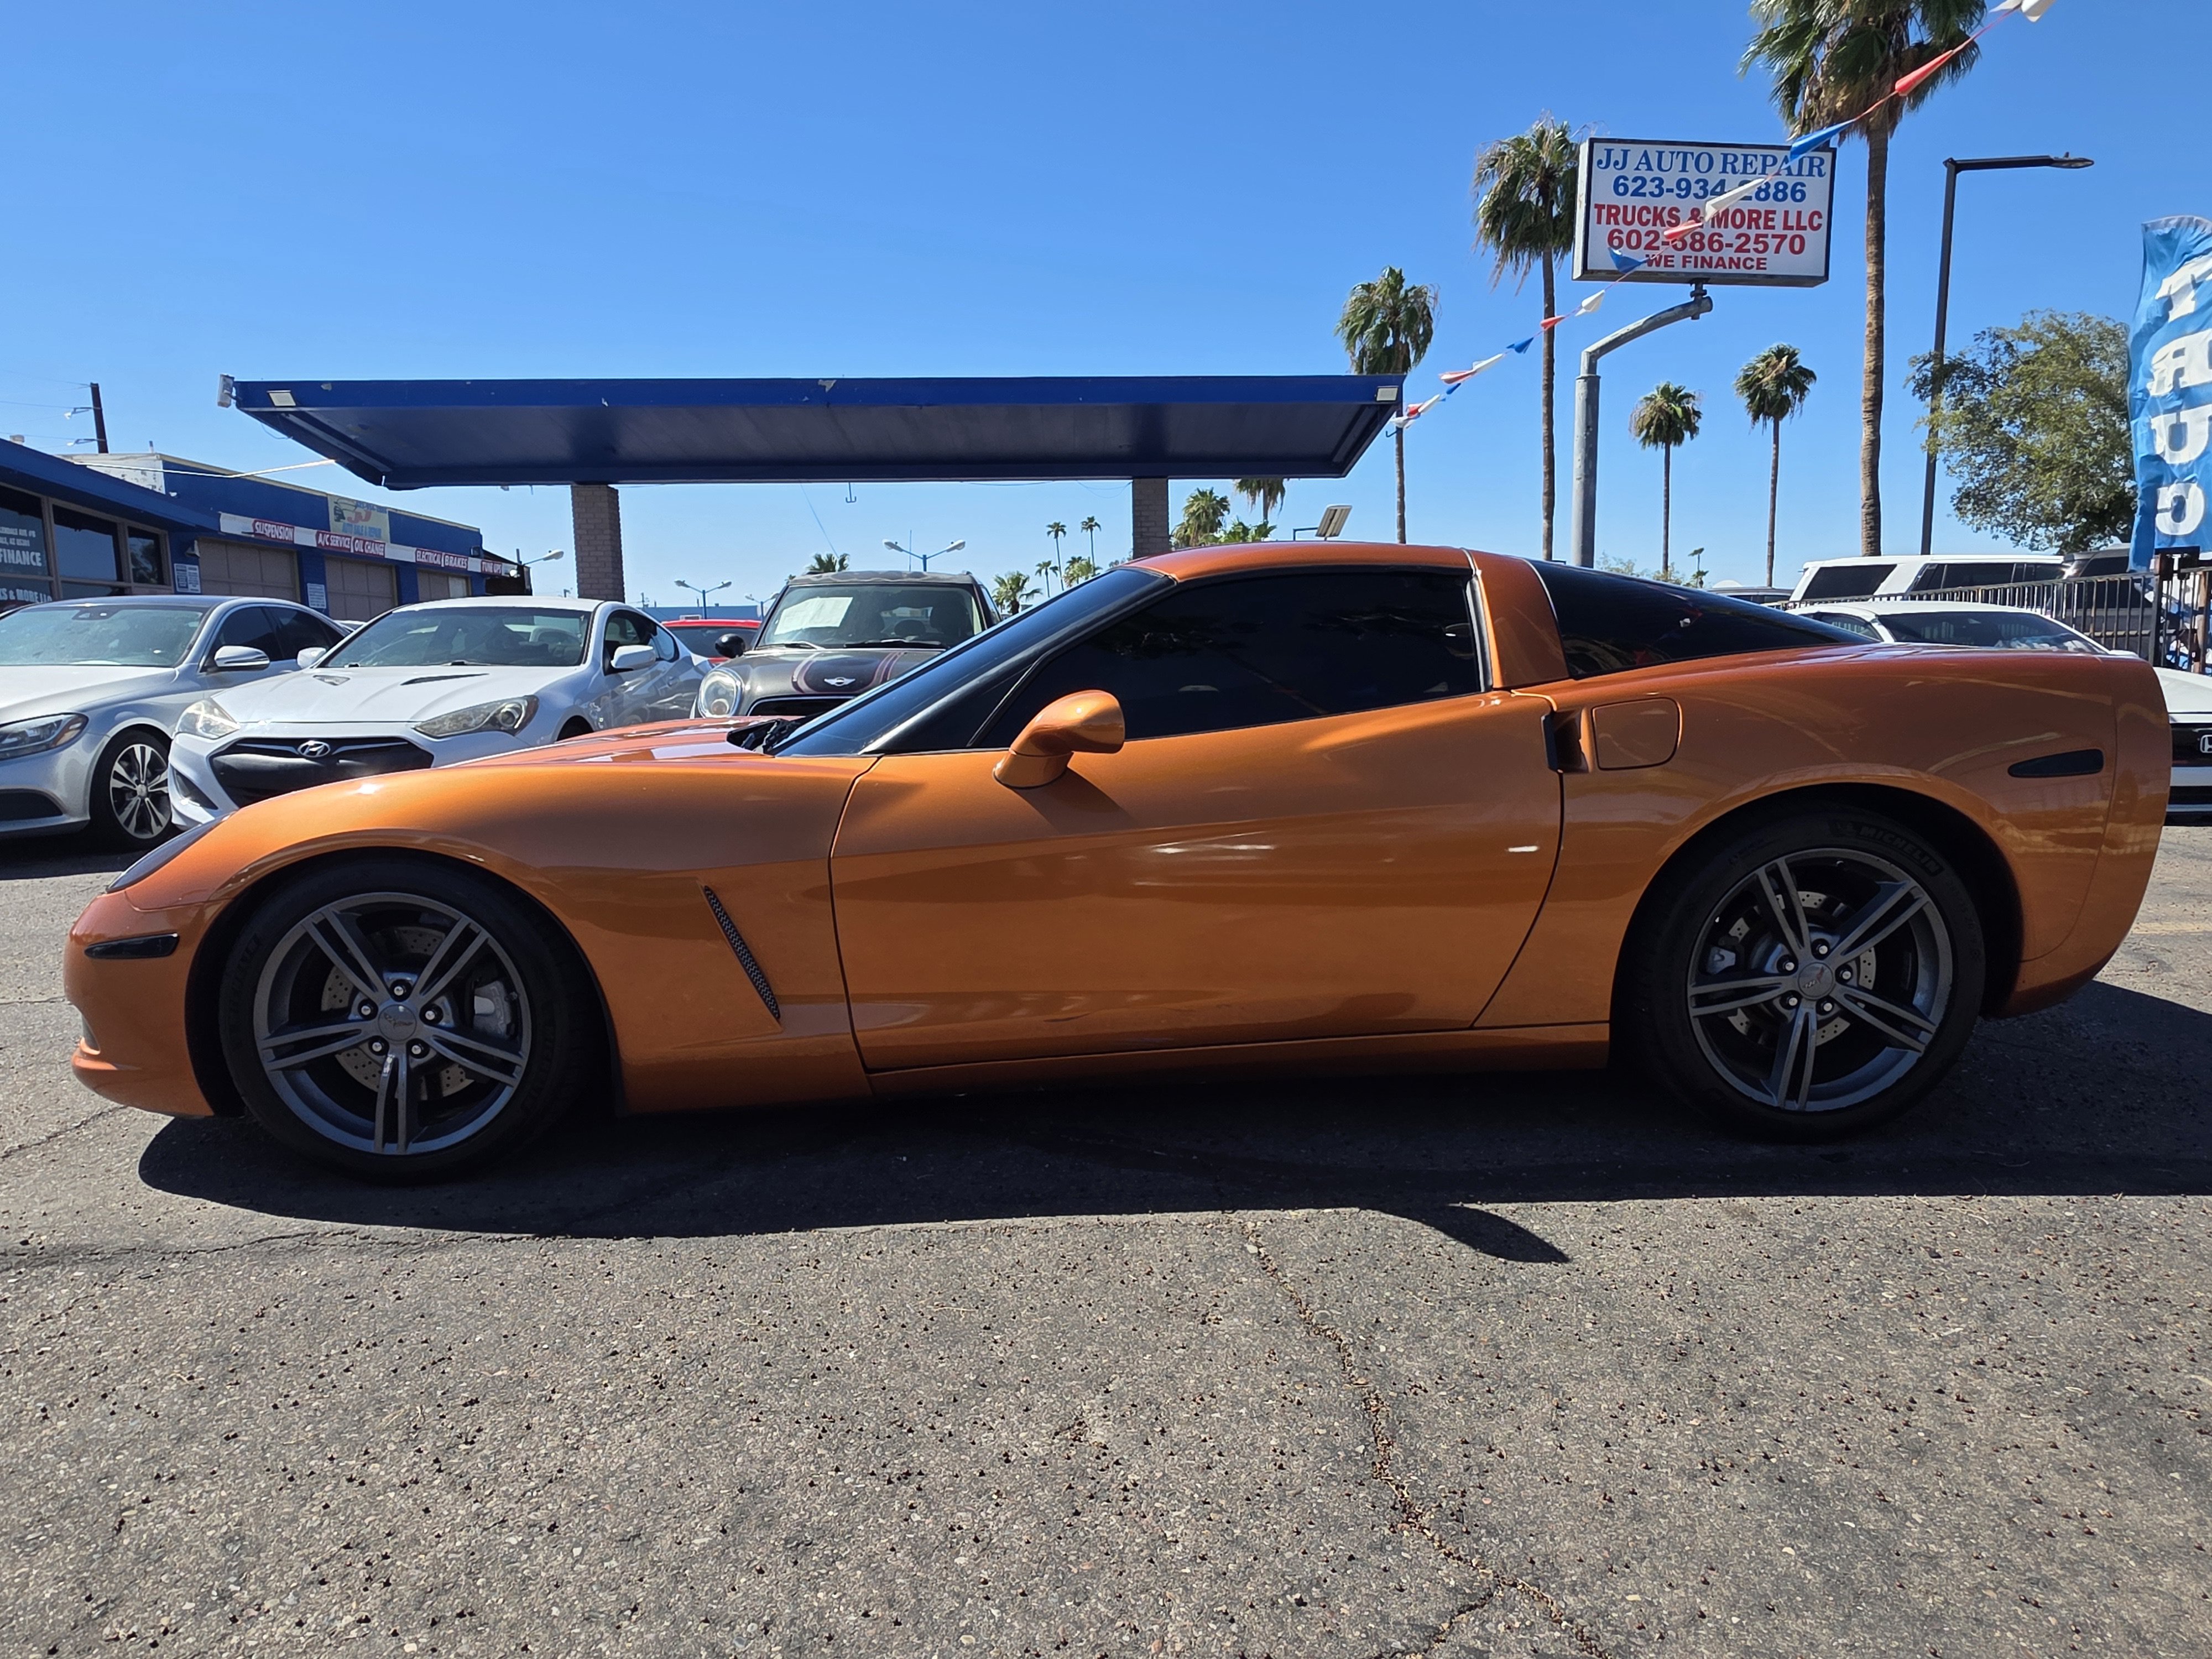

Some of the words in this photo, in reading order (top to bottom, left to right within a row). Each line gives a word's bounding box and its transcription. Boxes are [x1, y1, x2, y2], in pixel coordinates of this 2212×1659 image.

[1597, 148, 1631, 170] JJ
[1634, 149, 1714, 174] AUTO
[1719, 153, 1827, 178] REPAIR
[1594, 204, 1682, 228] TRUCKS
[1687, 207, 1704, 228] &
[1712, 208, 1776, 230] MORE
[1782, 210, 1823, 231] LLC
[1645, 254, 1674, 268] WE
[1682, 255, 1767, 270] FINANCE
[255, 521, 293, 541] SUSPENSION
[318, 533, 330, 546] A/C
[330, 535, 350, 548] SERVICE
[354, 540, 364, 552] OIL
[365, 541, 384, 555] CHANGE
[416, 550, 441, 565] ELECTRICAL
[445, 555, 468, 568] BRAKES
[1859, 826, 1940, 873] MICHELIN
